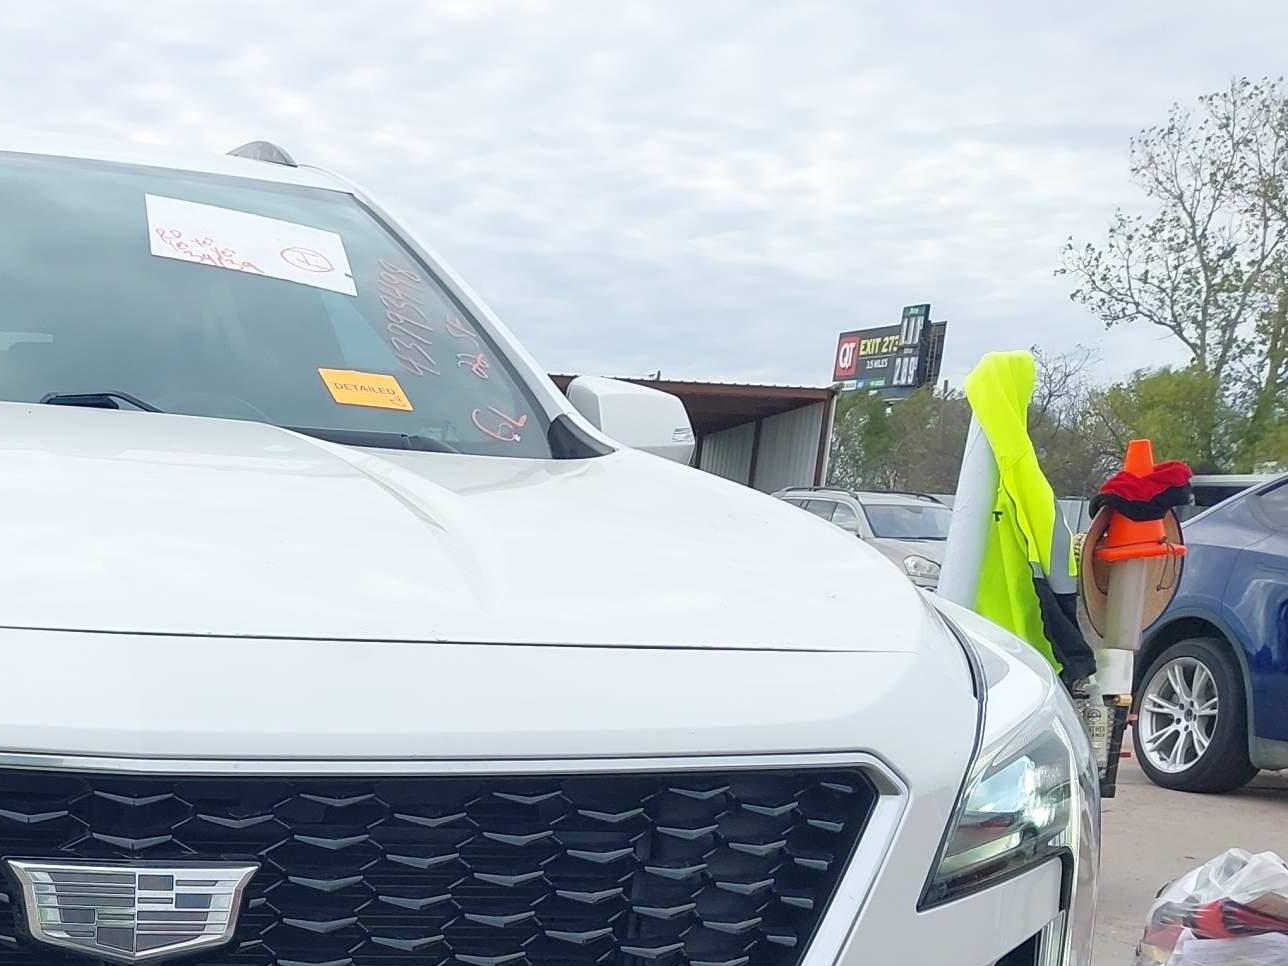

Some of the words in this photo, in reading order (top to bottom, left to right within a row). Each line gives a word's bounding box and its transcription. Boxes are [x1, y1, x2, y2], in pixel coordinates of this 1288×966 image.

[839, 342, 856, 369] QT
[859, 337, 882, 356] EXIT
[333, 382, 396, 396] DETAILED
